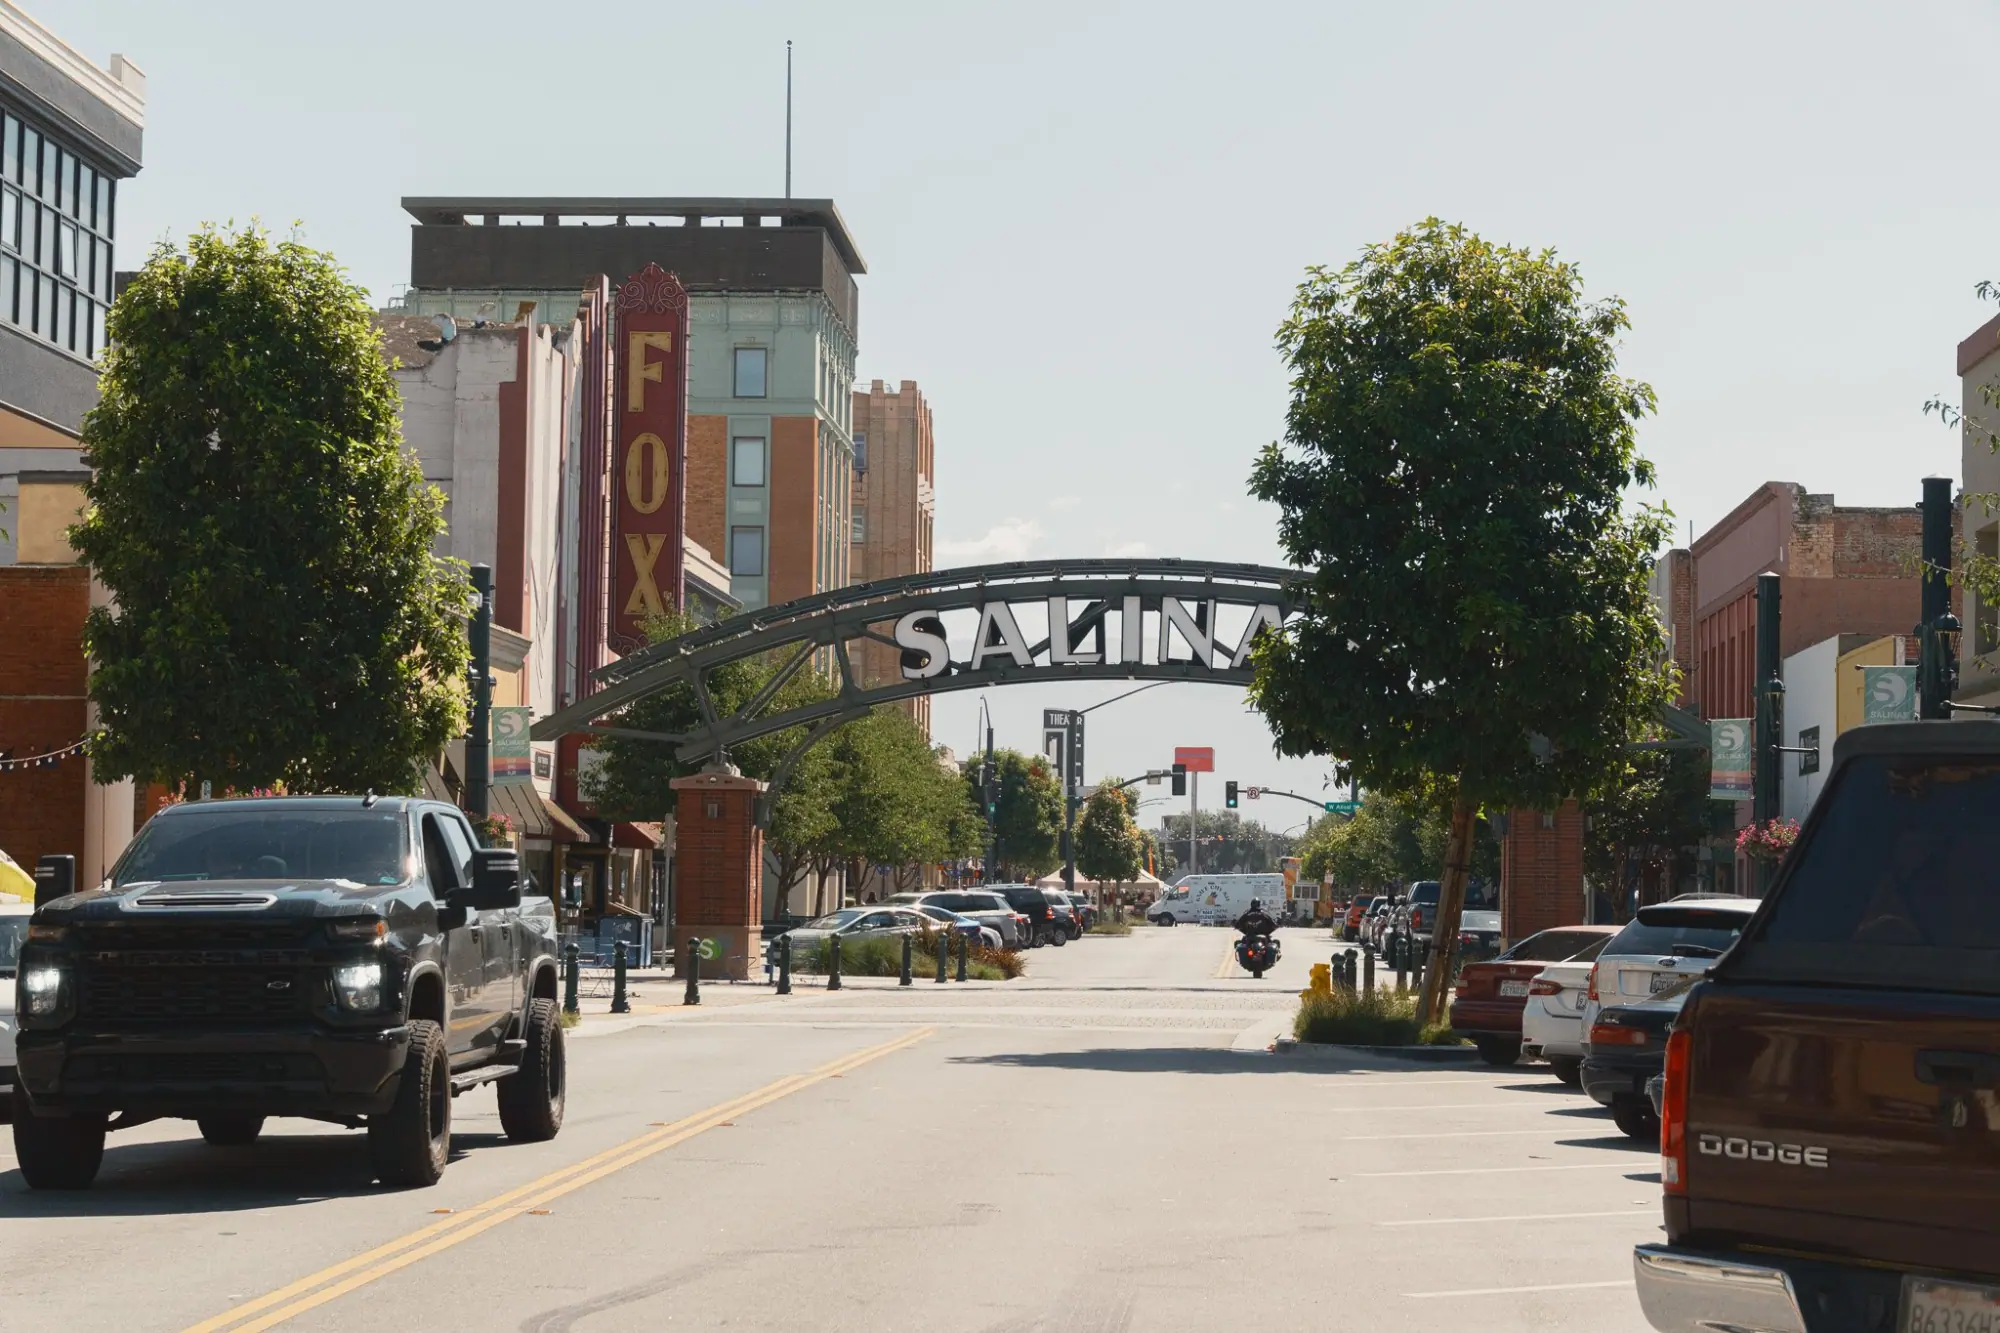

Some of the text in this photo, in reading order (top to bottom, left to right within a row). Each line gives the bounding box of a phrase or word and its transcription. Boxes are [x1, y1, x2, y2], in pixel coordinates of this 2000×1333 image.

[624, 331, 671, 615] FOX
[894, 596, 1285, 679] SALINA
[1699, 1134, 1828, 1168] DODGE
